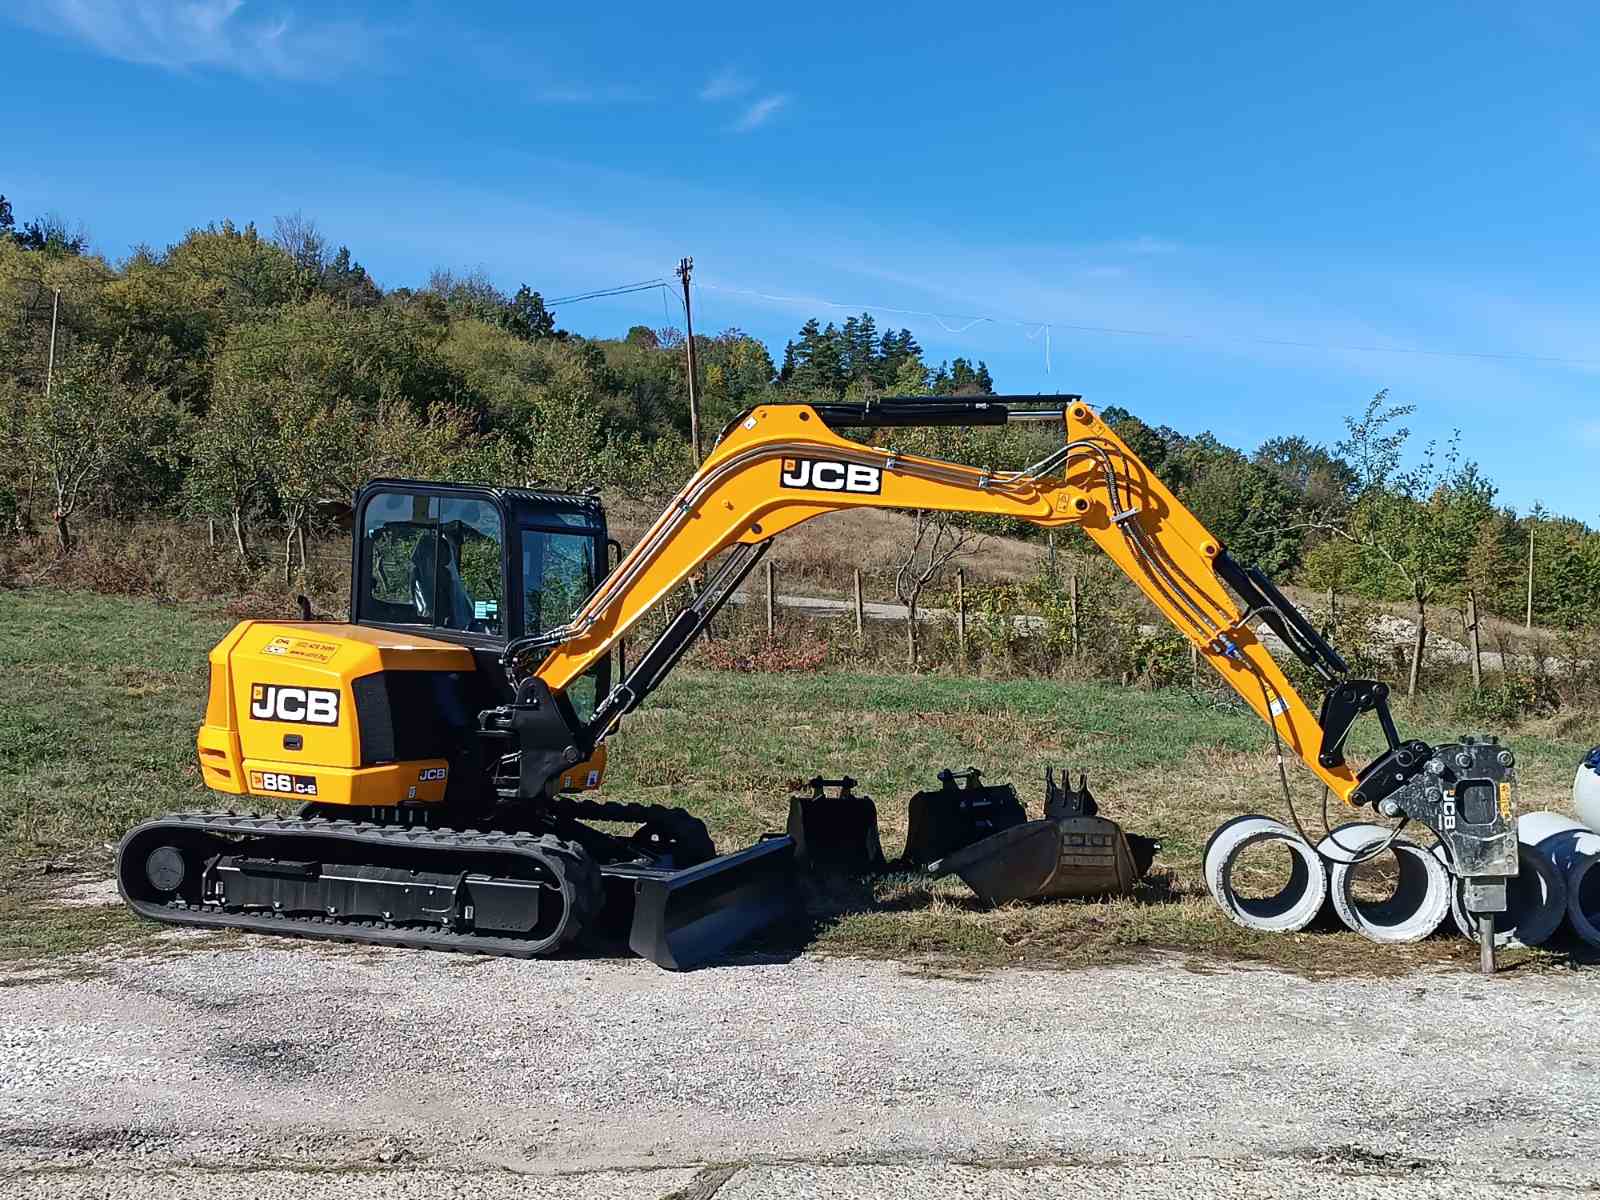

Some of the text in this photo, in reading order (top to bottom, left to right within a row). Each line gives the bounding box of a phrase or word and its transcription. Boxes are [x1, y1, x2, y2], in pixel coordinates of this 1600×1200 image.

[783, 460, 880, 492] JCB
[252, 687, 338, 723] JCB
[263, 773, 291, 791] 86
[419, 768, 446, 781] JCB
[1443, 790, 1456, 830] JCB
